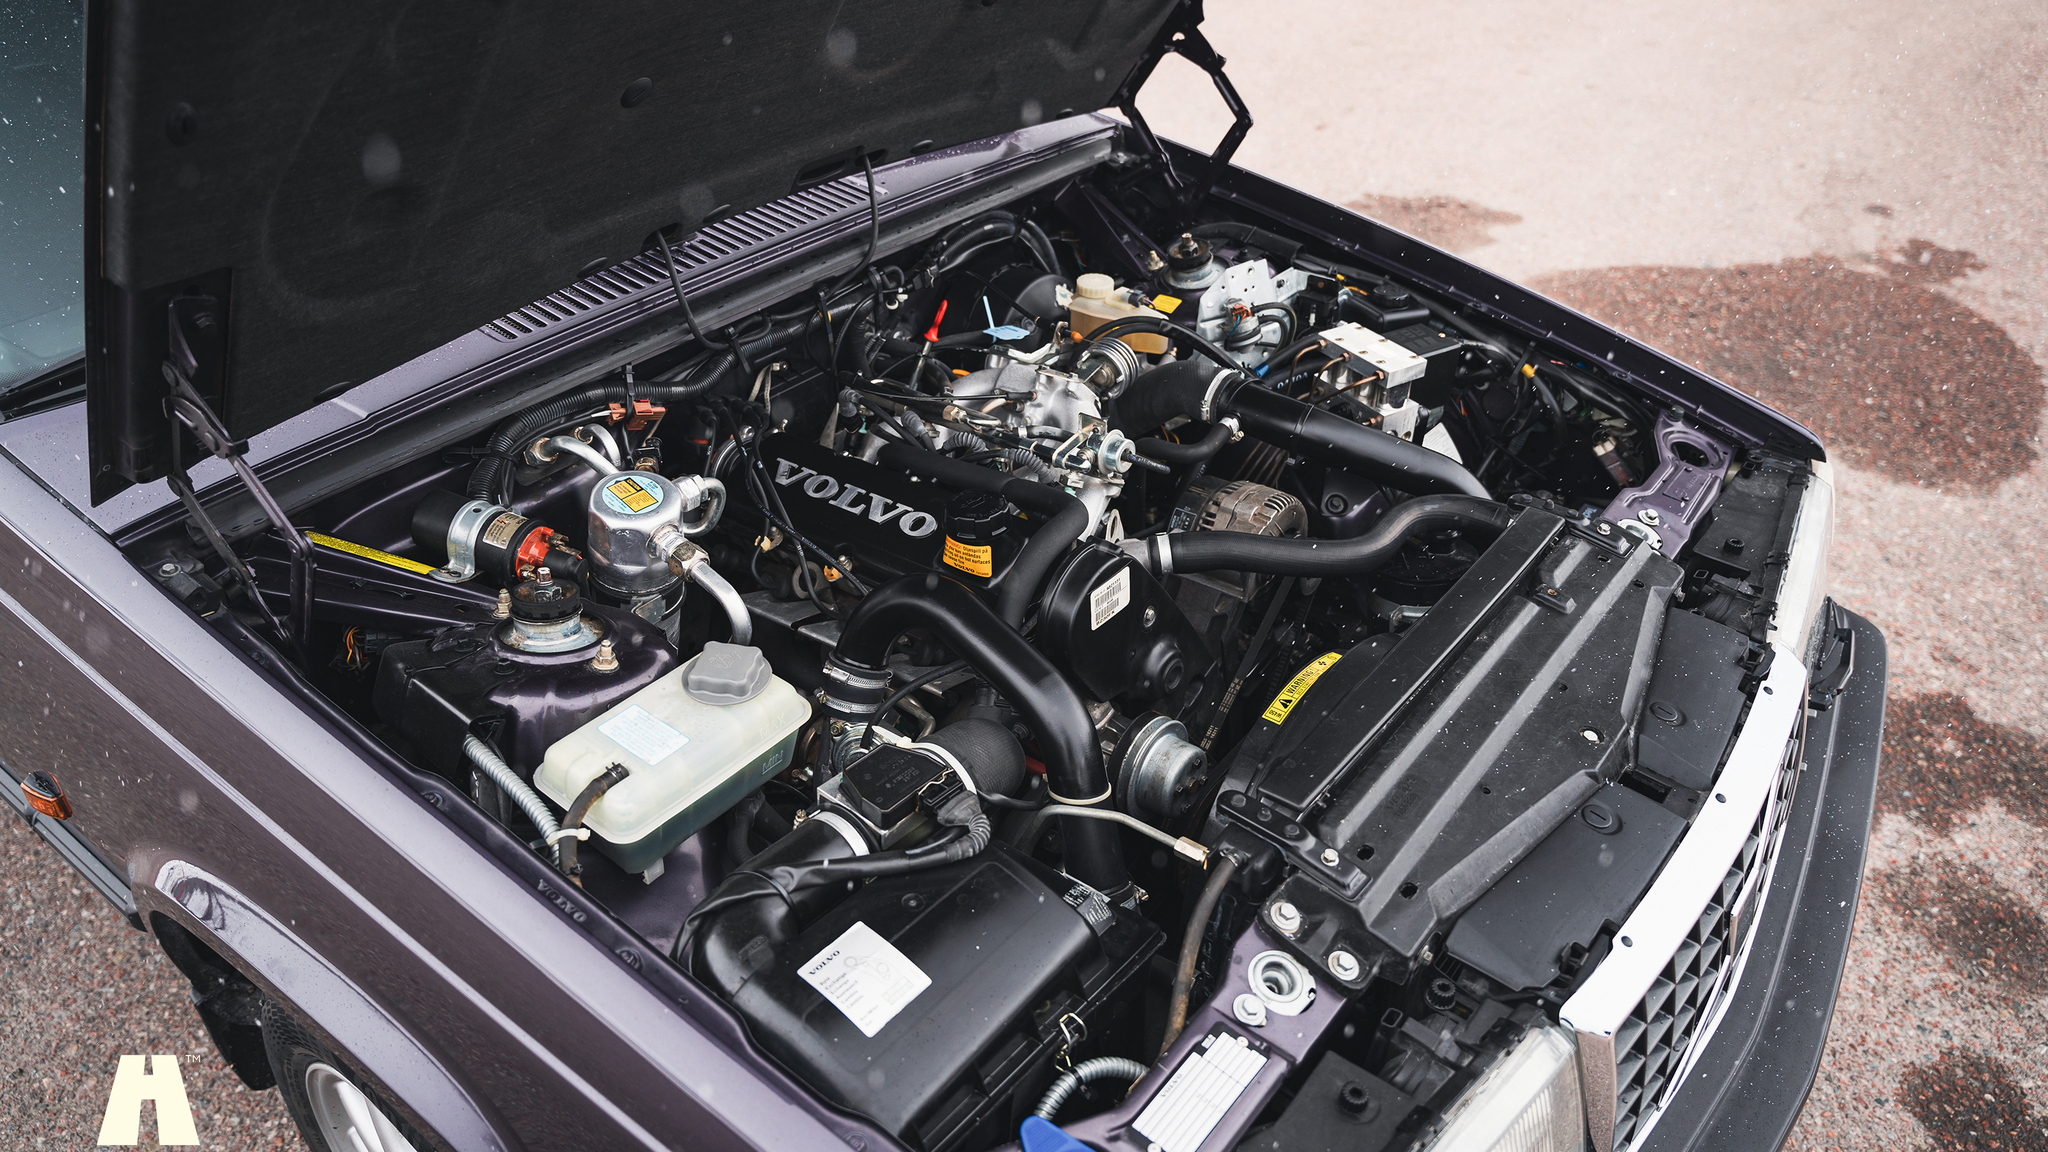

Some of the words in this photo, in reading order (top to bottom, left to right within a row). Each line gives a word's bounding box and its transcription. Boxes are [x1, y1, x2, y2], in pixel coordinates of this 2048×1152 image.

[775, 457, 938, 539] VOLVO
[954, 562, 975, 573] VOLVO
[762, 750, 784, 774] MIN
[537, 879, 587, 922] VOLVO
[809, 950, 840, 975] VOLVO
[1160, 1073, 1183, 1098] VOLVO
